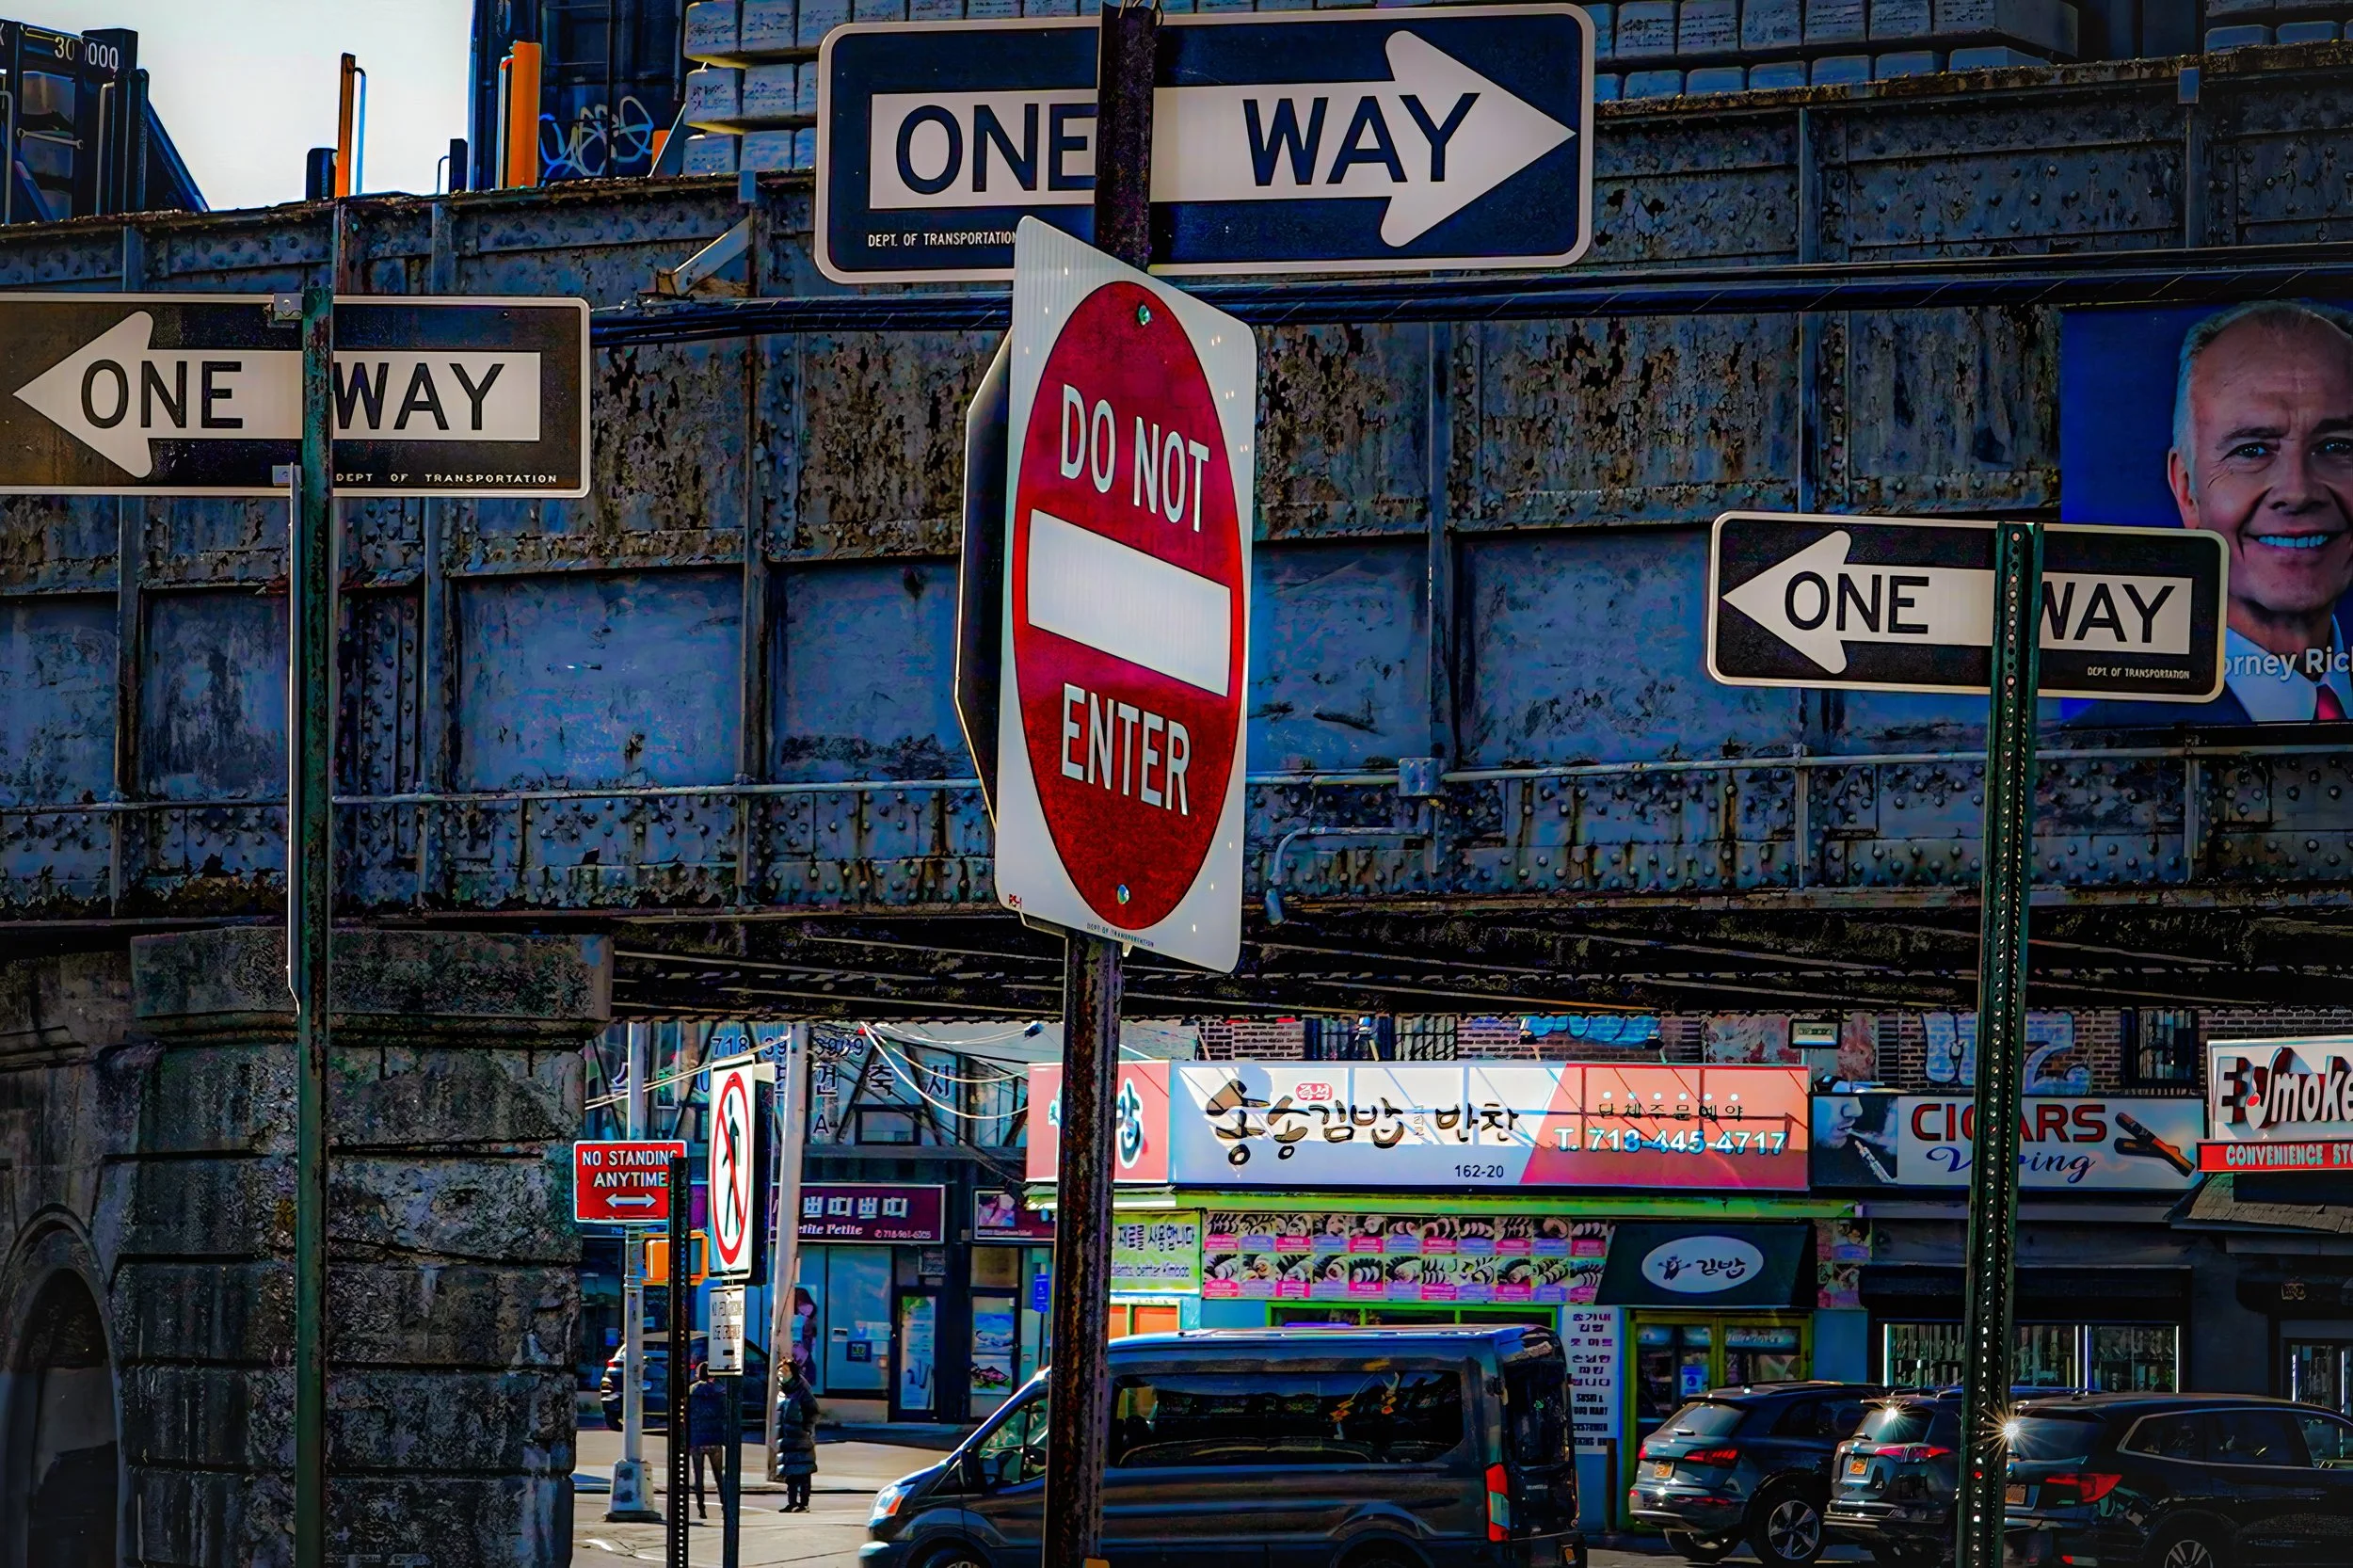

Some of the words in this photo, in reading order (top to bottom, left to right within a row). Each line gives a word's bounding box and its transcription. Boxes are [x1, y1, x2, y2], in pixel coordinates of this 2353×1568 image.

[54, 36, 119, 69] 30000
[894, 103, 1097, 195] ONE
[1242, 92, 1481, 187] WAY
[868, 233, 898, 248] DEPT.
[903, 232, 918, 247] OF
[81, 359, 243, 430] ONE
[333, 361, 504, 431] WAY
[1060, 383, 1116, 494] DO
[1133, 416, 1210, 533] NOT
[335, 473, 373, 483] DEPT
[391, 473, 408, 483] OF
[425, 473, 557, 484] TRANSPORTATION
[1785, 570, 1930, 635] ONE
[2041, 581, 2176, 644] WAY
[2110, 667, 2121, 677] OF
[2124, 667, 2190, 680] TRANSPORTATION
[2306, 646, 2353, 675] Ric
[1061, 681, 1193, 817] ENTER
[712, 1037, 749, 1055] 718
[1434, 1102, 1521, 1143] 반찬
[1554, 1128, 1580, 1152] T.
[1588, 1128, 1788, 1156] 718-445-4717
[2226, 1144, 2324, 1166] CONVENIENCE
[582, 1150, 601, 1166] NO
[1454, 1164, 1505, 1179] 162-20
[1926, 1146, 2096, 1184] Ving
[593, 1172, 668, 1187] ANYTIME
[1147, 1224, 1195, 1252] 사용합니다
[1696, 1257, 1746, 1280] 김밥
